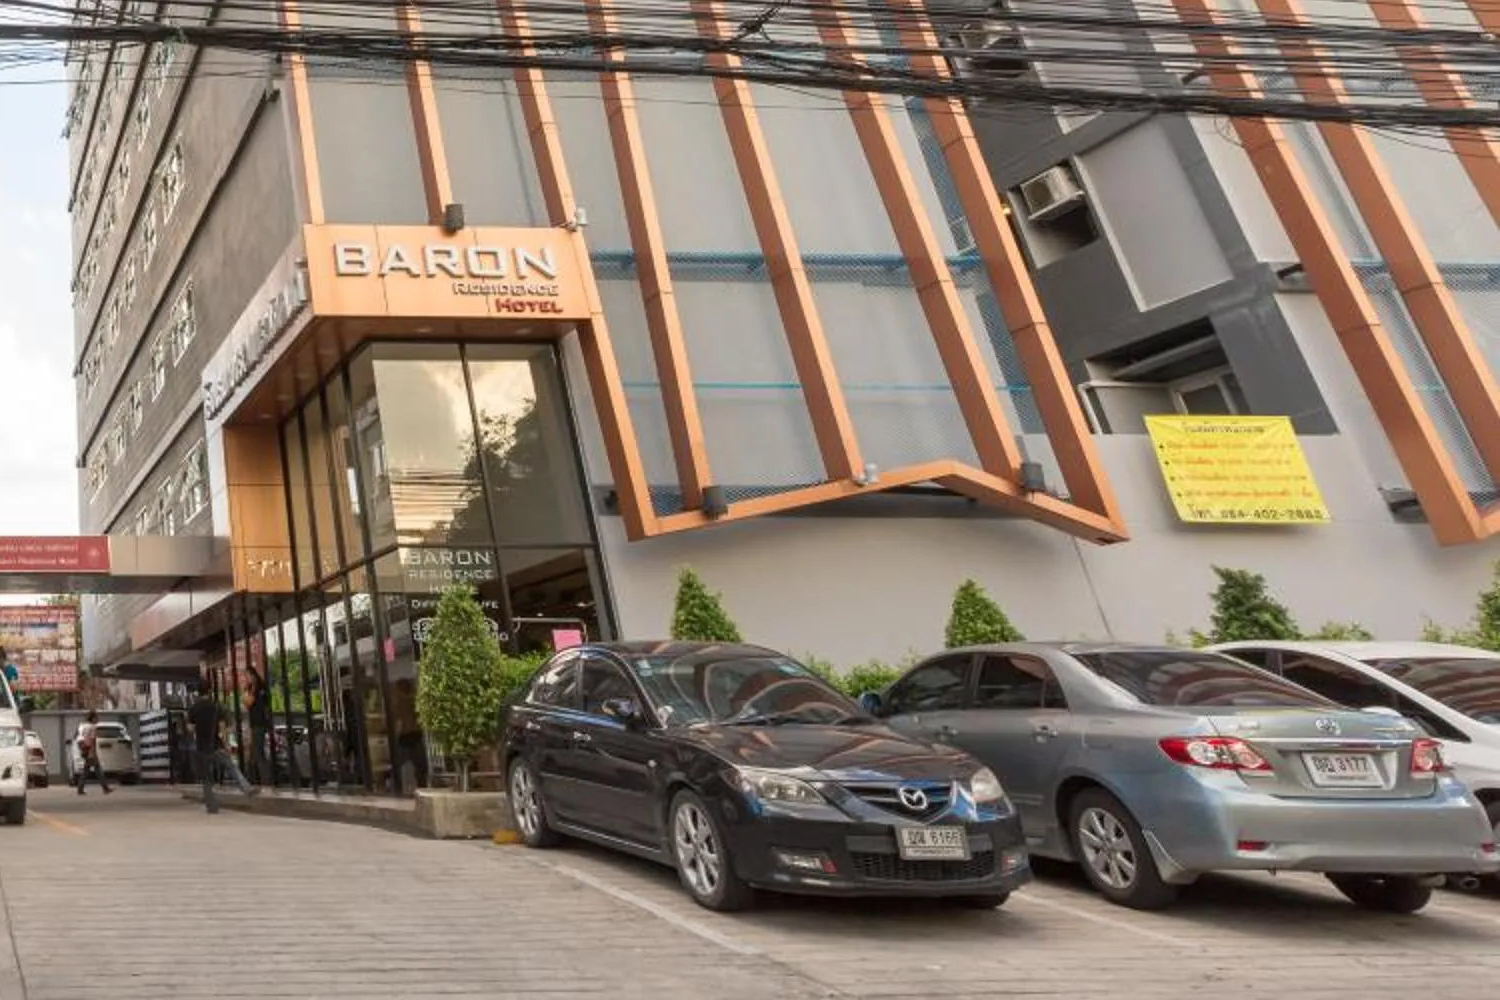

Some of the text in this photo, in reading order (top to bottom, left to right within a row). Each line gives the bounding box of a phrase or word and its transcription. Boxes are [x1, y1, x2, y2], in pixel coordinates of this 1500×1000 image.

[333, 242, 557, 280] BARON
[451, 282, 560, 297] RESIDENCE
[494, 297, 564, 314] HOTEL
[399, 550, 493, 566] BARON
